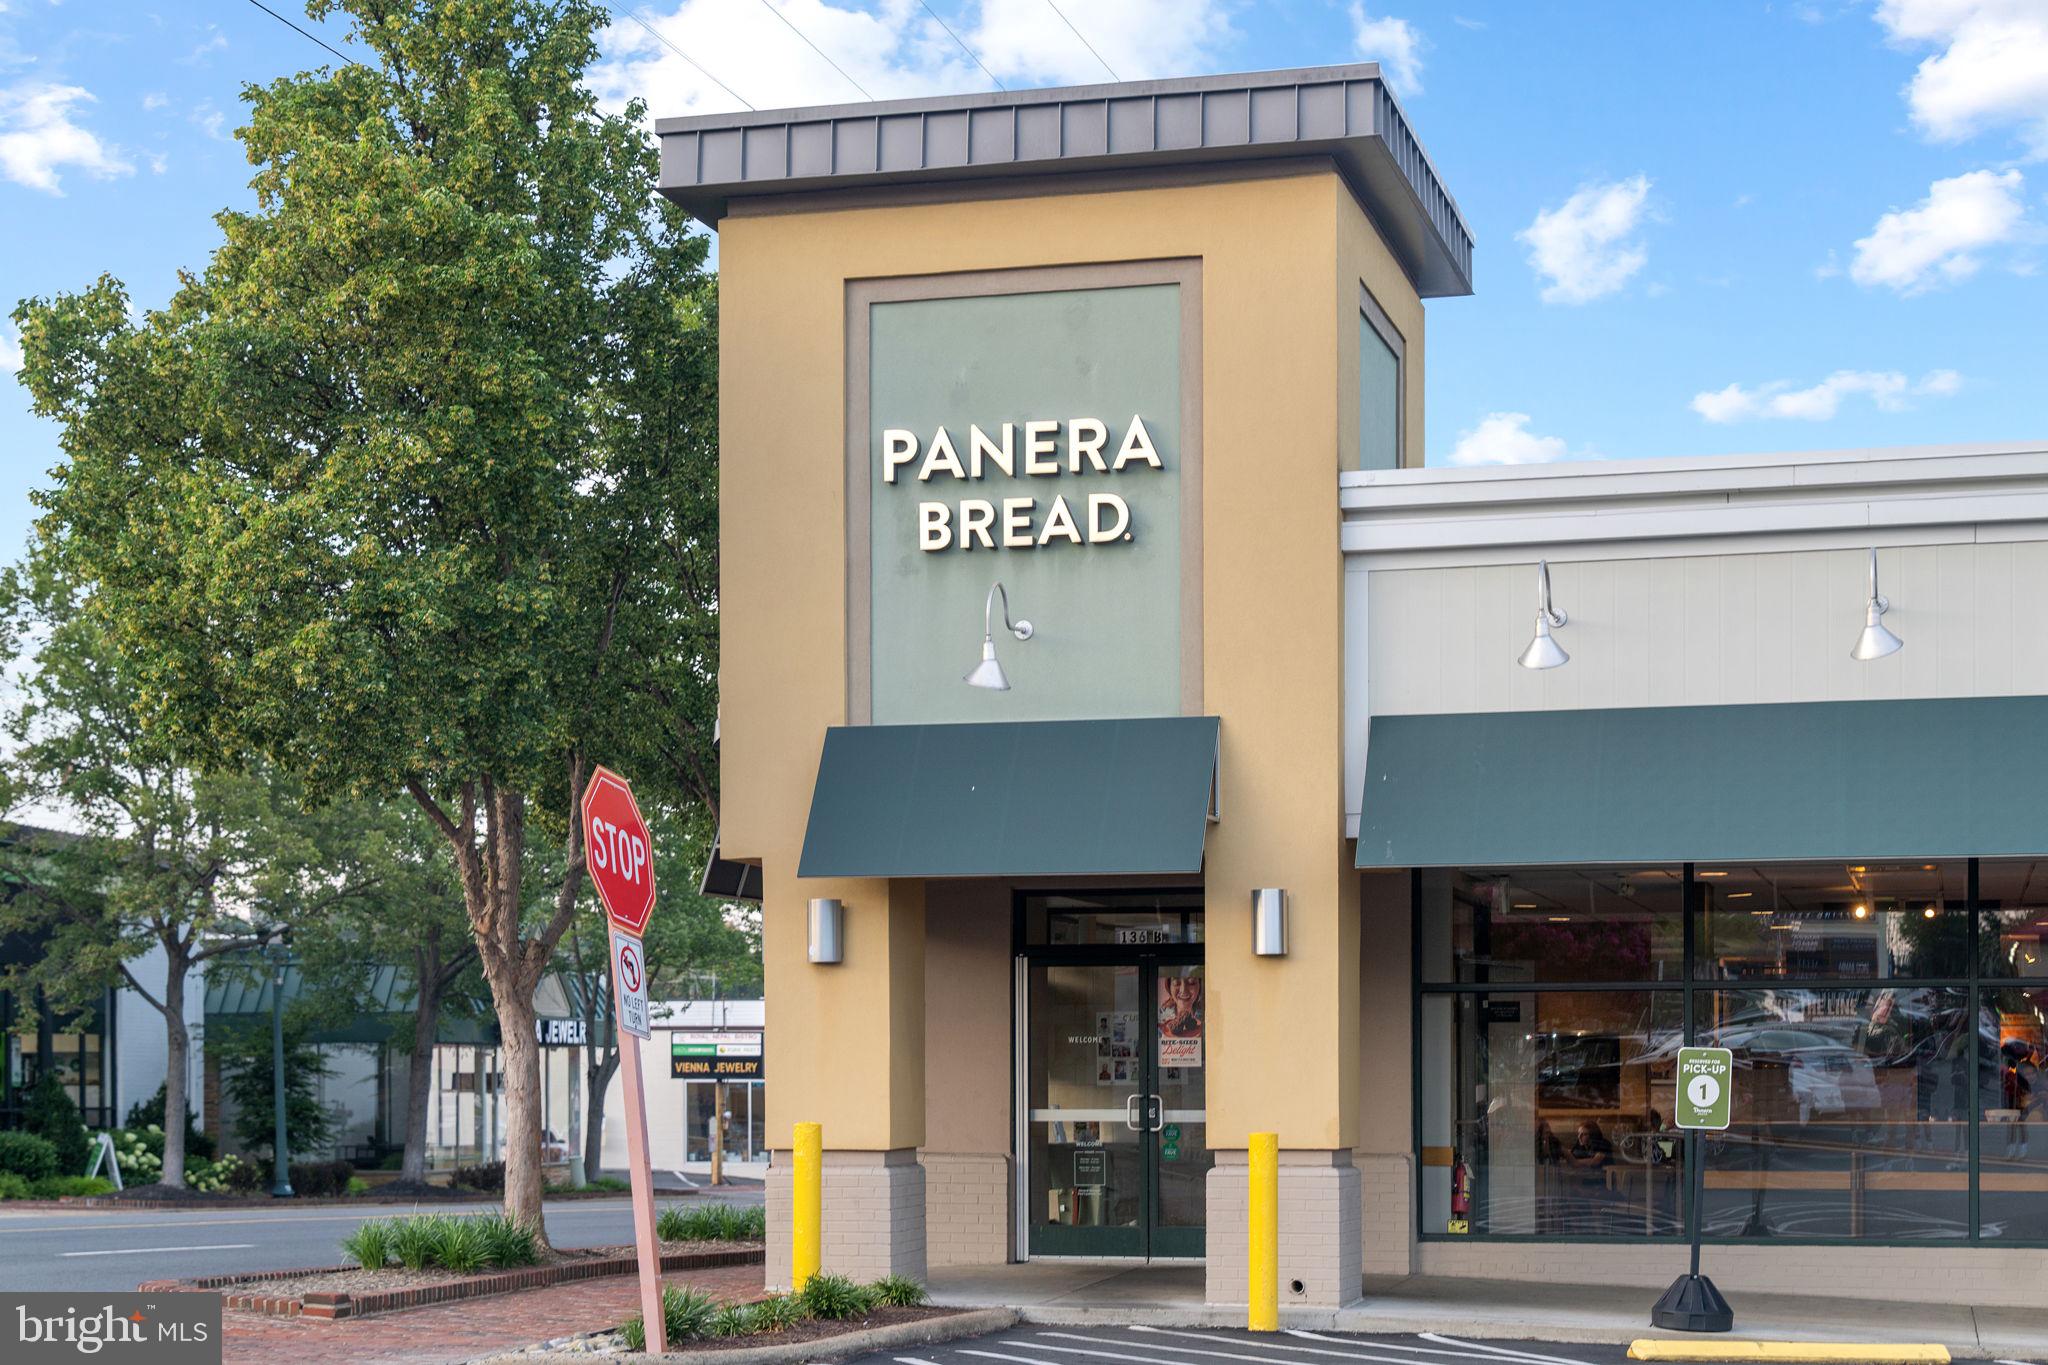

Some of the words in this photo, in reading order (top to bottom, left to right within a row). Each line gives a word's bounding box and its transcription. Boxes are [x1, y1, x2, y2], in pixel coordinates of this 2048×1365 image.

[883, 414, 1163, 483] PANERA
[592, 816, 646, 885] STOP
[1121, 930, 1147, 943] 136
[623, 994, 632, 1008] NO
[631, 996, 644, 1012] LEFT
[628, 1010, 642, 1025] TURN
[545, 1020, 587, 1044] JEWELR
[1067, 1036, 1104, 1044] WELCOME
[1162, 1044, 1197, 1057] Delight
[675, 1062, 710, 1073] VIENNA
[713, 1061, 758, 1073] JEWELRY
[1683, 1064, 1727, 1075] PICK-UP
[1699, 1083, 1707, 1100] 1
